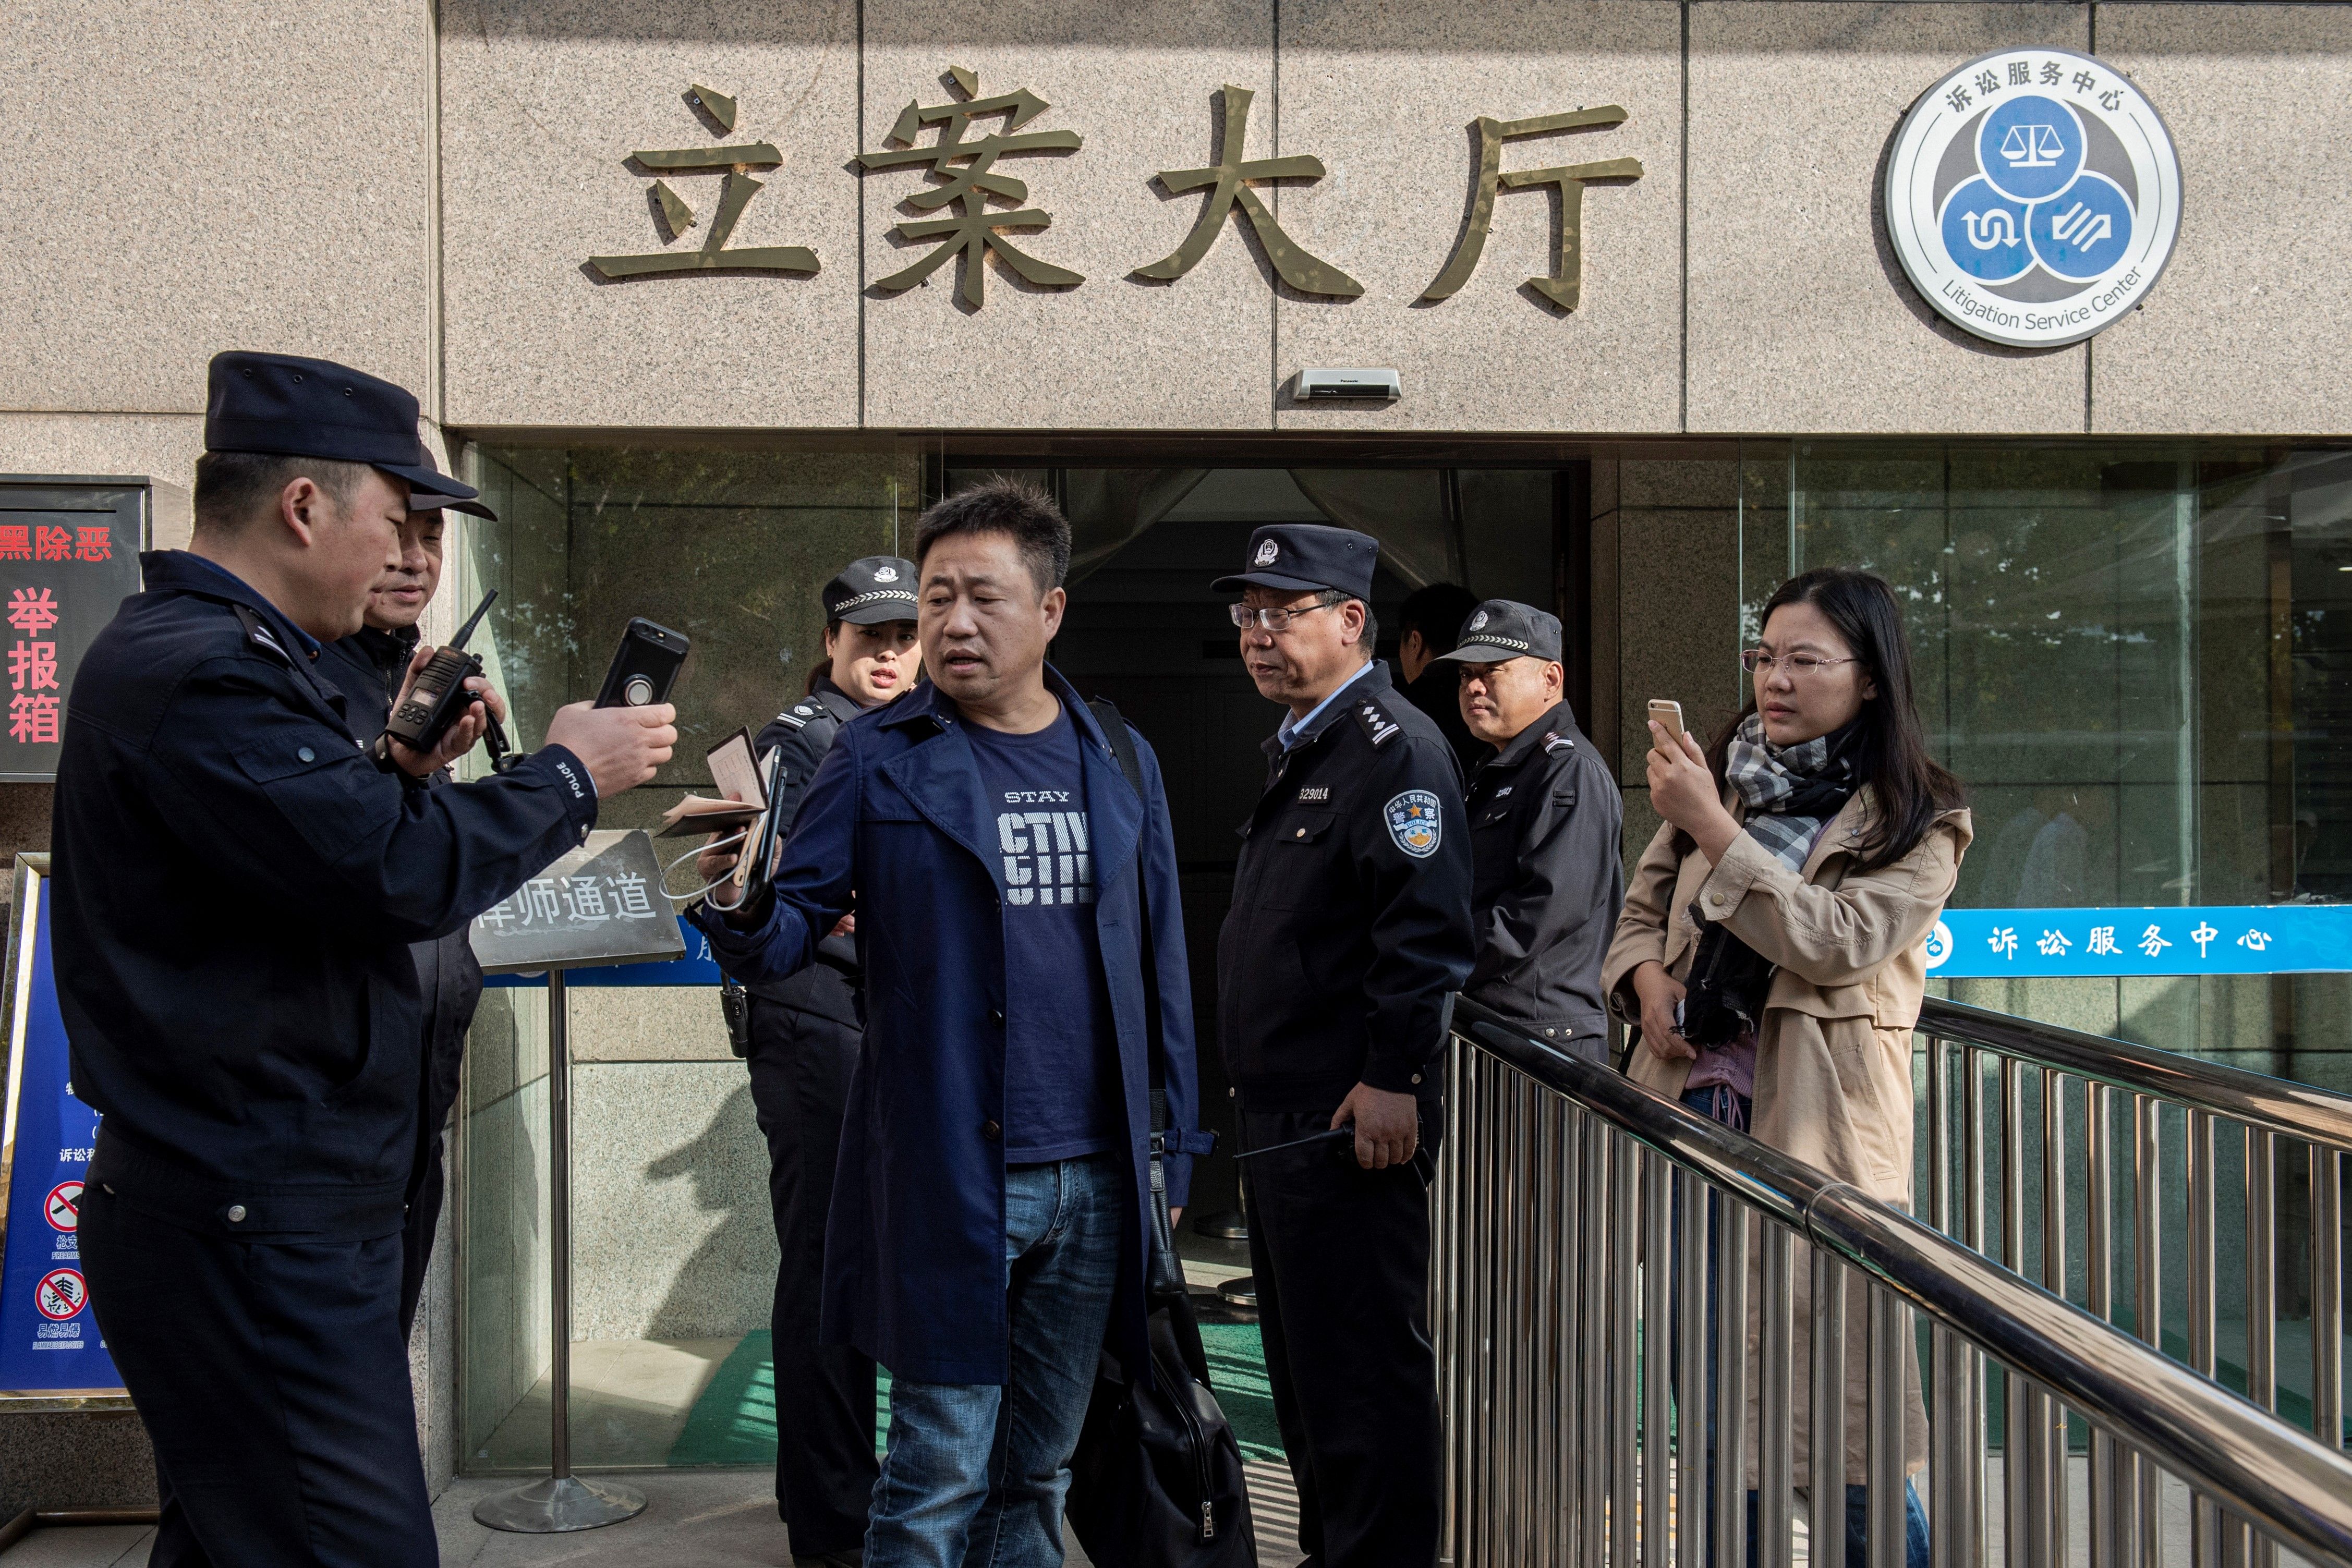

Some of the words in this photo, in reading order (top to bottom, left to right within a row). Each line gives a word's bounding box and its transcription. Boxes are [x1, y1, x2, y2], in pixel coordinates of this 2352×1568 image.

[1946, 60, 2125, 114] 诉讼服务中心
[589, 64, 1644, 313] 立案大厅
[1942, 279, 2020, 329] Litigation
[2026, 304, 2089, 330] Service
[2092, 266, 2141, 313] Center
[0, 525, 112, 562] 黑除恶
[7, 587, 60, 744] 举报箱
[556, 762, 584, 798] POLICE
[1004, 791, 1070, 803] STAY
[1299, 788, 1328, 799] 329014
[1388, 794, 1436, 813] 中华人民共和国
[1987, 921, 2273, 960] 诉讼服务中心
[52, 1251, 80, 1260] FIREARMS
[56, 1235, 78, 1250] 枪支
[37, 1323, 80, 1339] 易燃易爆
